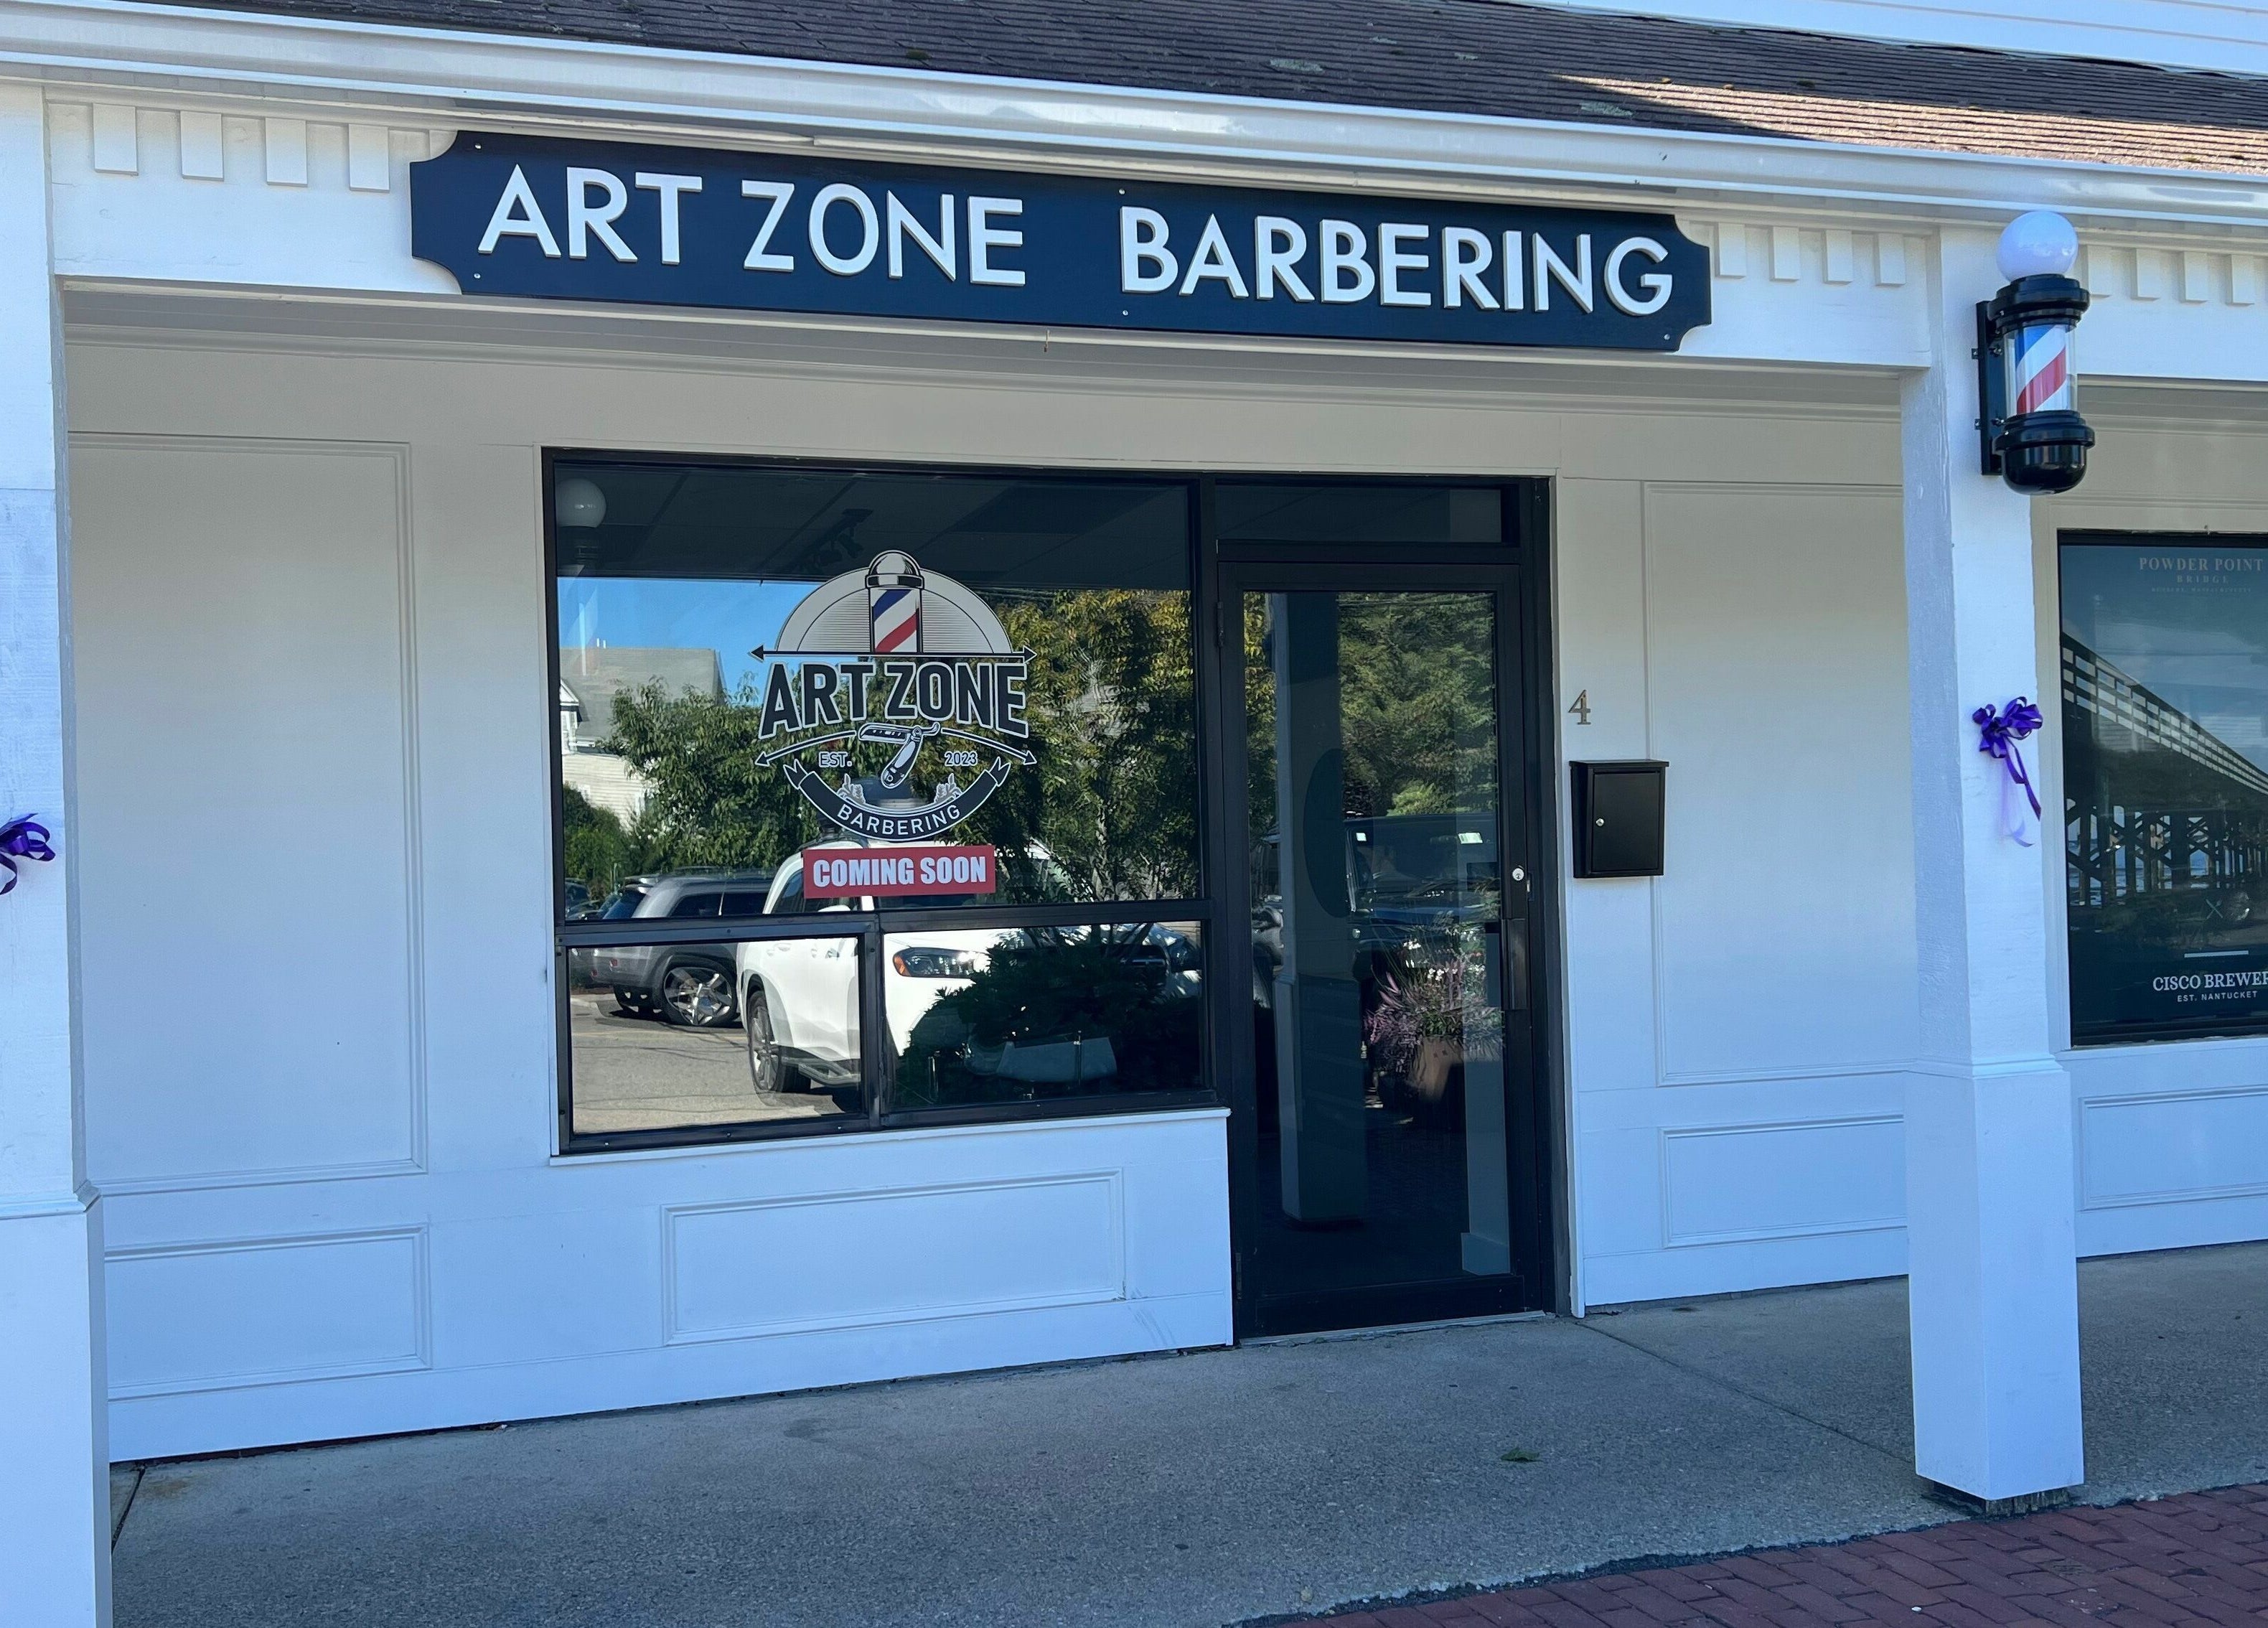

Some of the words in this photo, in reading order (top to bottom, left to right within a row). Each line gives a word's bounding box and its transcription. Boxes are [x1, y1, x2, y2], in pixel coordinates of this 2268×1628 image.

[478, 164, 702, 265] ART
[741, 180, 1026, 286] ZONE
[1120, 205, 1673, 317] BARBERING
[2139, 557, 2208, 571] POWDER
[2215, 558, 2264, 571] POINT
[759, 661, 876, 739] ART
[884, 661, 1029, 739] ZONE
[1568, 689, 1591, 725] 4
[818, 752, 852, 767] EST.
[944, 751, 978, 767] 2023
[837, 804, 961, 836] BARBERING
[813, 857, 914, 887] COMING
[920, 856, 986, 884] SOON
[2152, 975, 2201, 991] CISCO
[2201, 990, 2258, 1001] NANTUCKET
